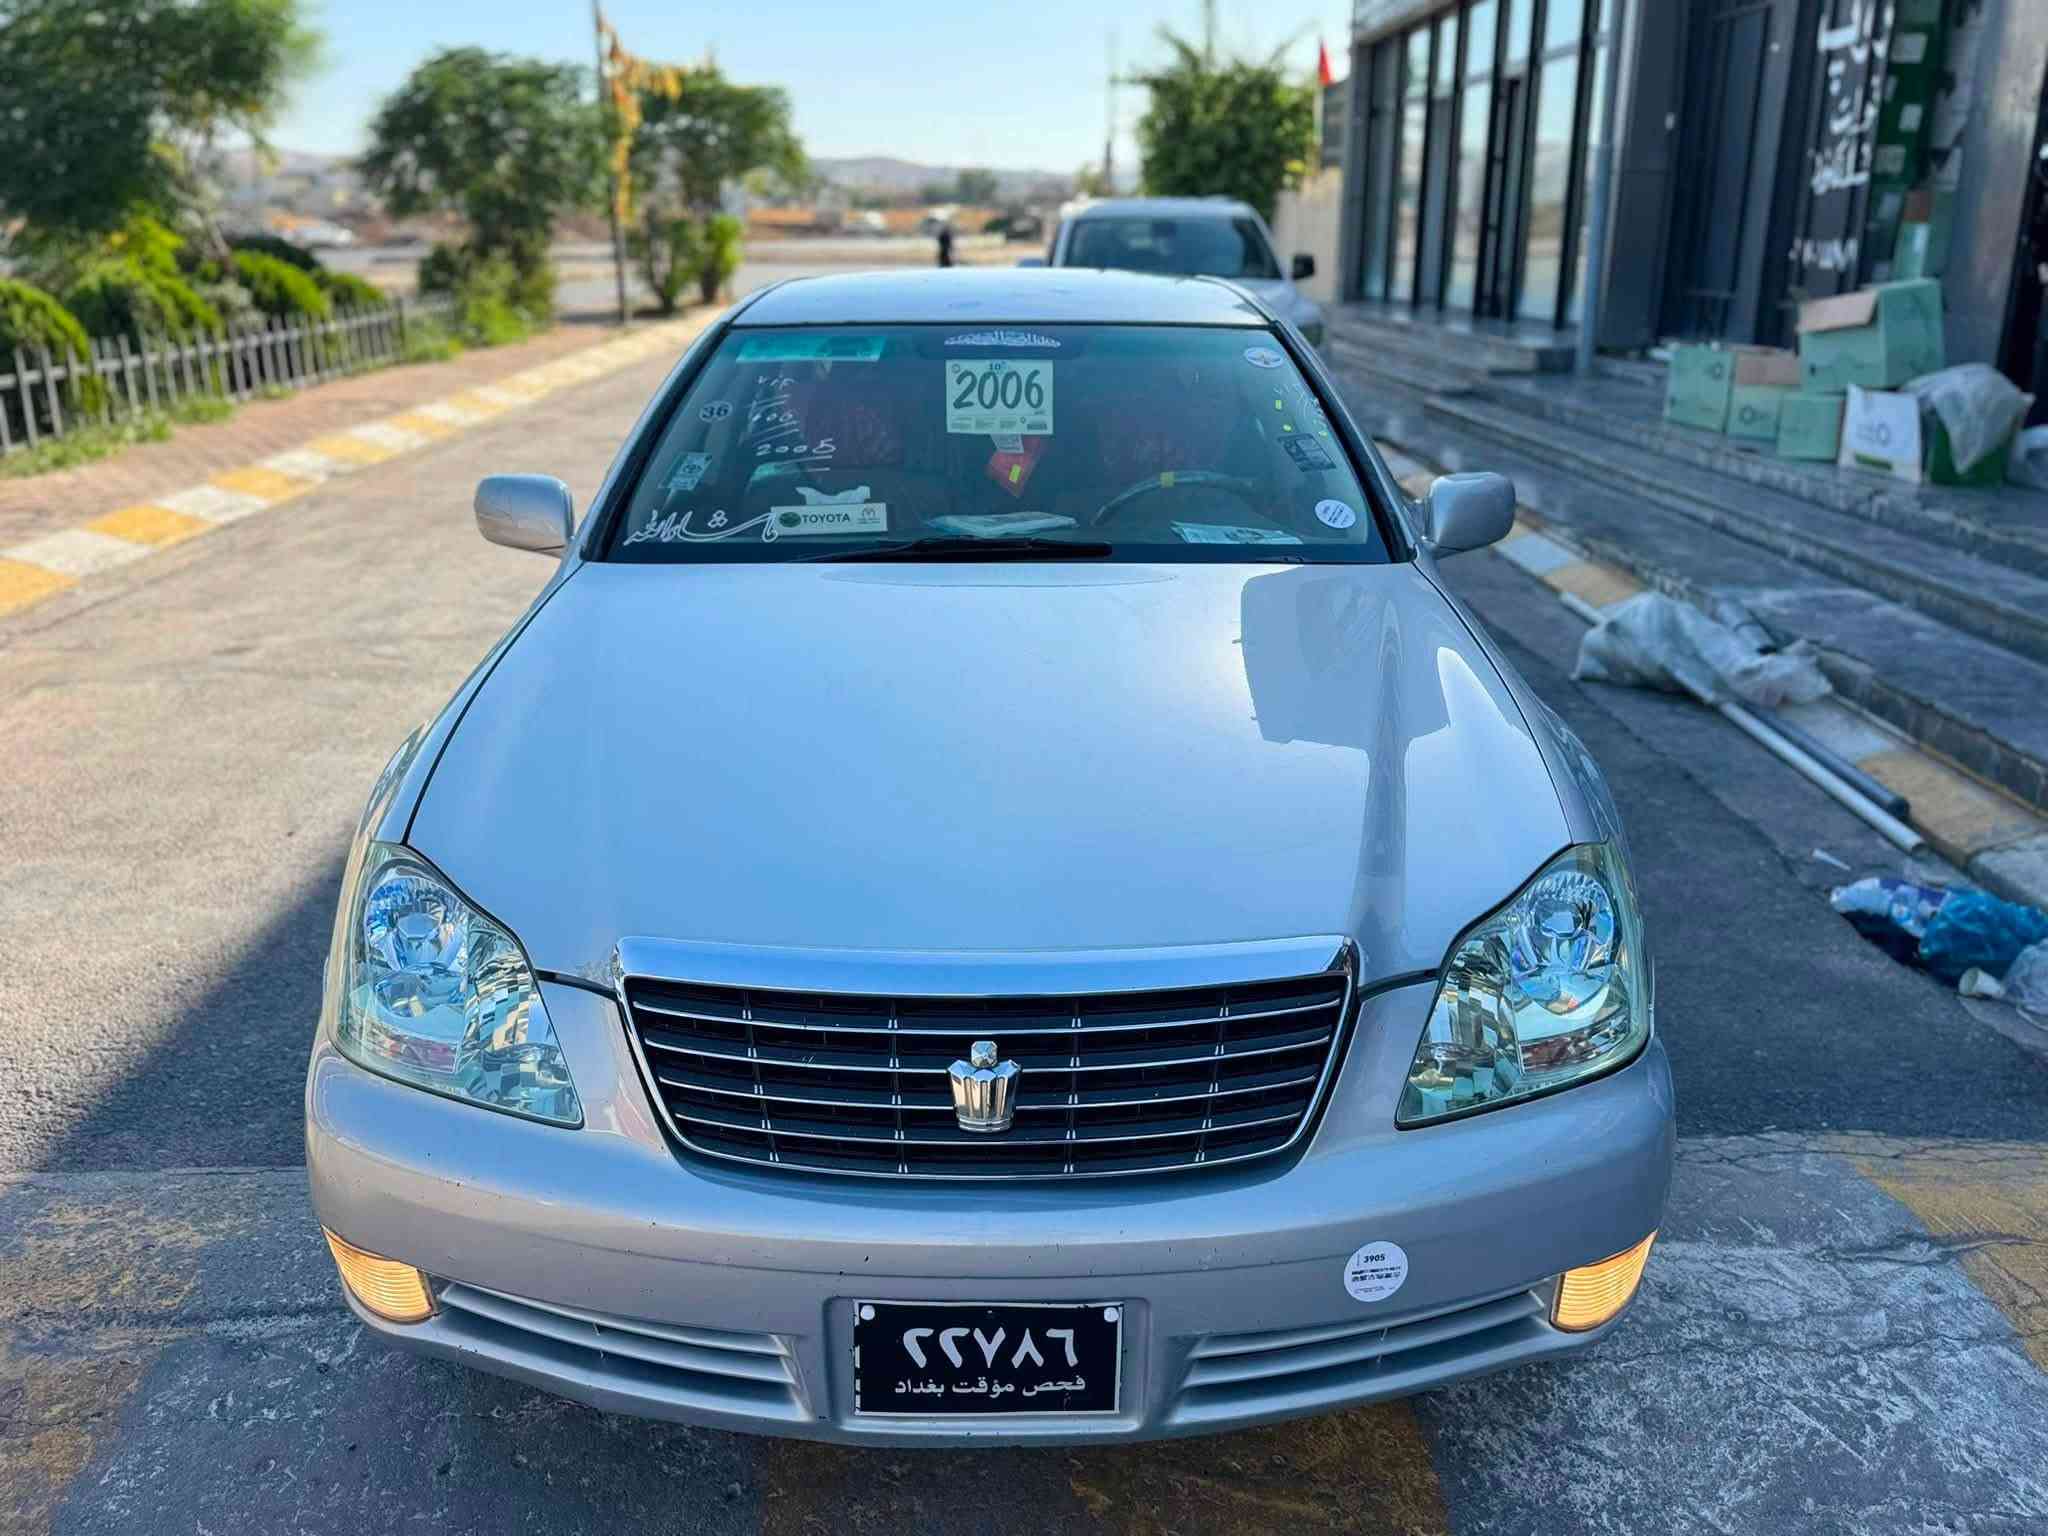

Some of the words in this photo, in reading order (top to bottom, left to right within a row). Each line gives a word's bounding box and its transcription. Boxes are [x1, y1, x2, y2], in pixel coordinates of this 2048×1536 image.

[953, 369, 1044, 410] 2006
[801, 513, 850, 524] TOYOTA
[1363, 1253, 1386, 1264] 3905
[902, 1327, 1079, 1369] ٢٢٧٨٦
[895, 1378, 945, 1397] بغداد
[952, 1376, 1015, 1398] مؤقت
[1022, 1375, 1087, 1397] فحص
